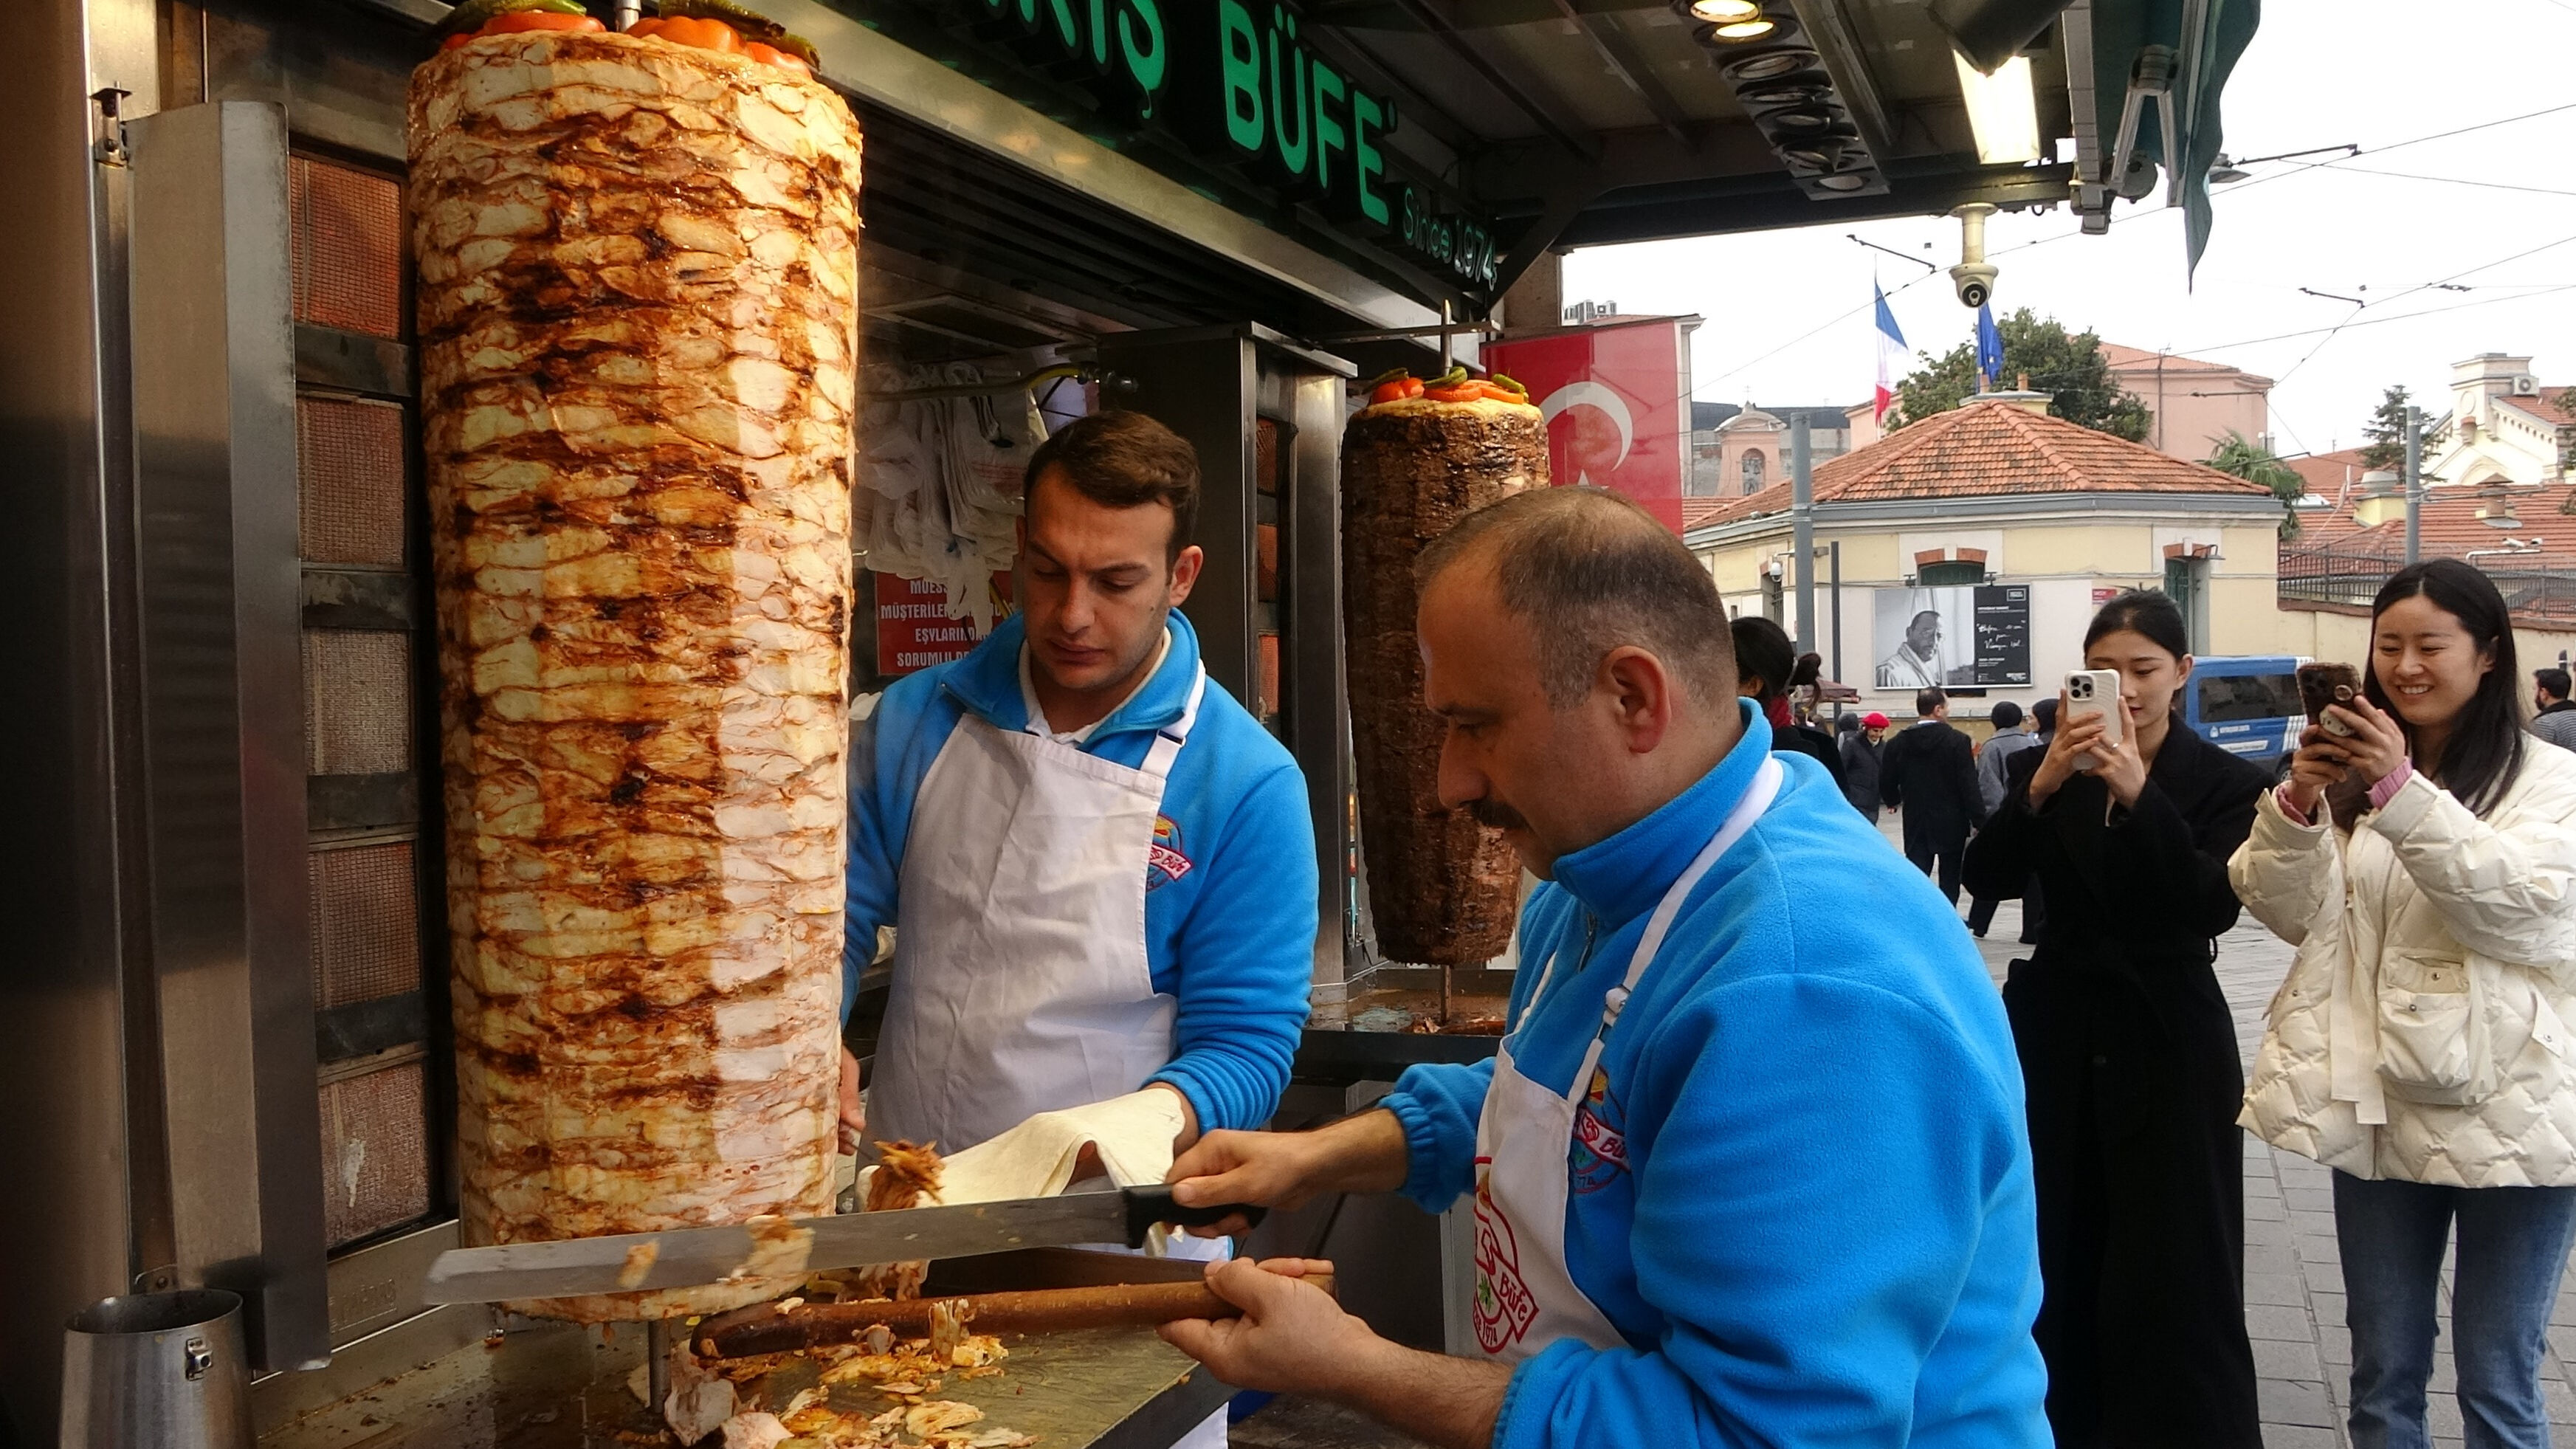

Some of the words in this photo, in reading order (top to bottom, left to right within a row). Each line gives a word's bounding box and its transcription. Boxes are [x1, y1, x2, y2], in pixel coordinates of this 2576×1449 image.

[1220, 0, 1389, 225] BÜFE
[1405, 187, 1450, 262] Since
[1454, 219, 1497, 291] 1974
[1482, 1321, 1498, 1346] 1974
[1500, 1272, 1528, 1322] Büfe
